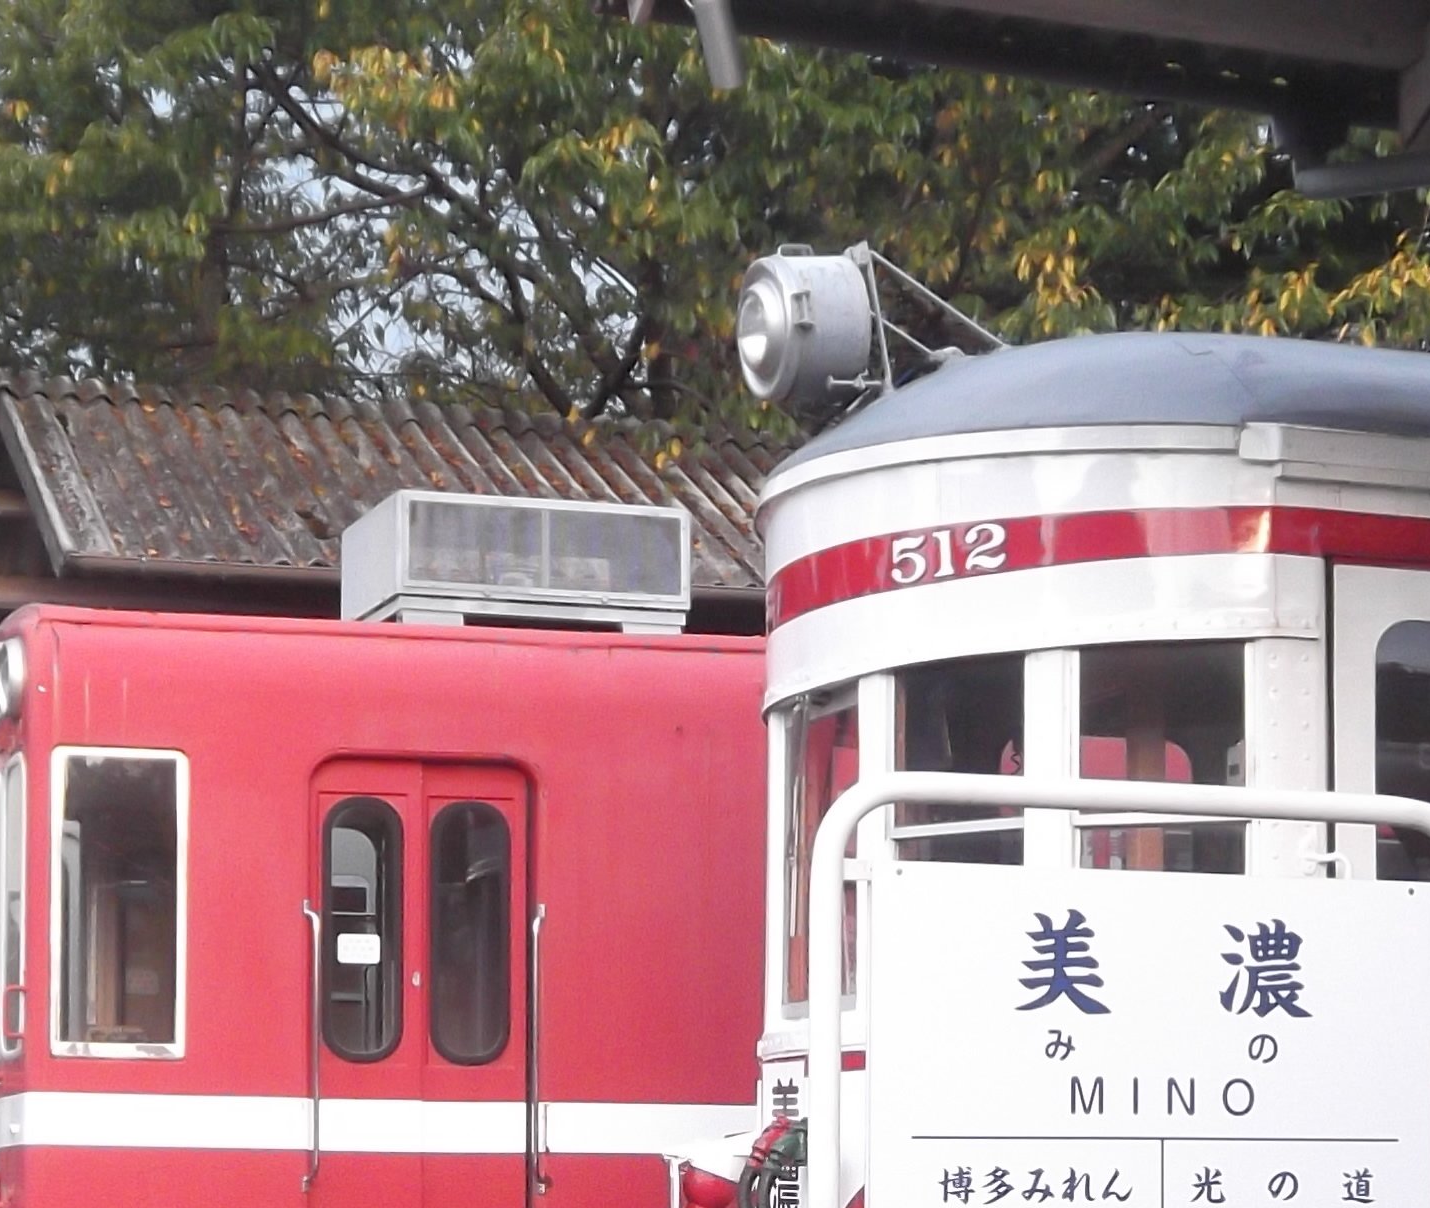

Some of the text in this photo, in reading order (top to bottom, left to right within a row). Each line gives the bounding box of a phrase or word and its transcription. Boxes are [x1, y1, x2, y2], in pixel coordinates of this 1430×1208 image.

[891, 523, 1007, 584] 512
[1015, 908, 1313, 1018] 美濃
[1044, 1029, 1278, 1064] みの
[1070, 1076, 1256, 1116] MINO
[938, 1166, 1133, 1205] 博多みれん
[1190, 1167, 1376, 1204] 光の道
